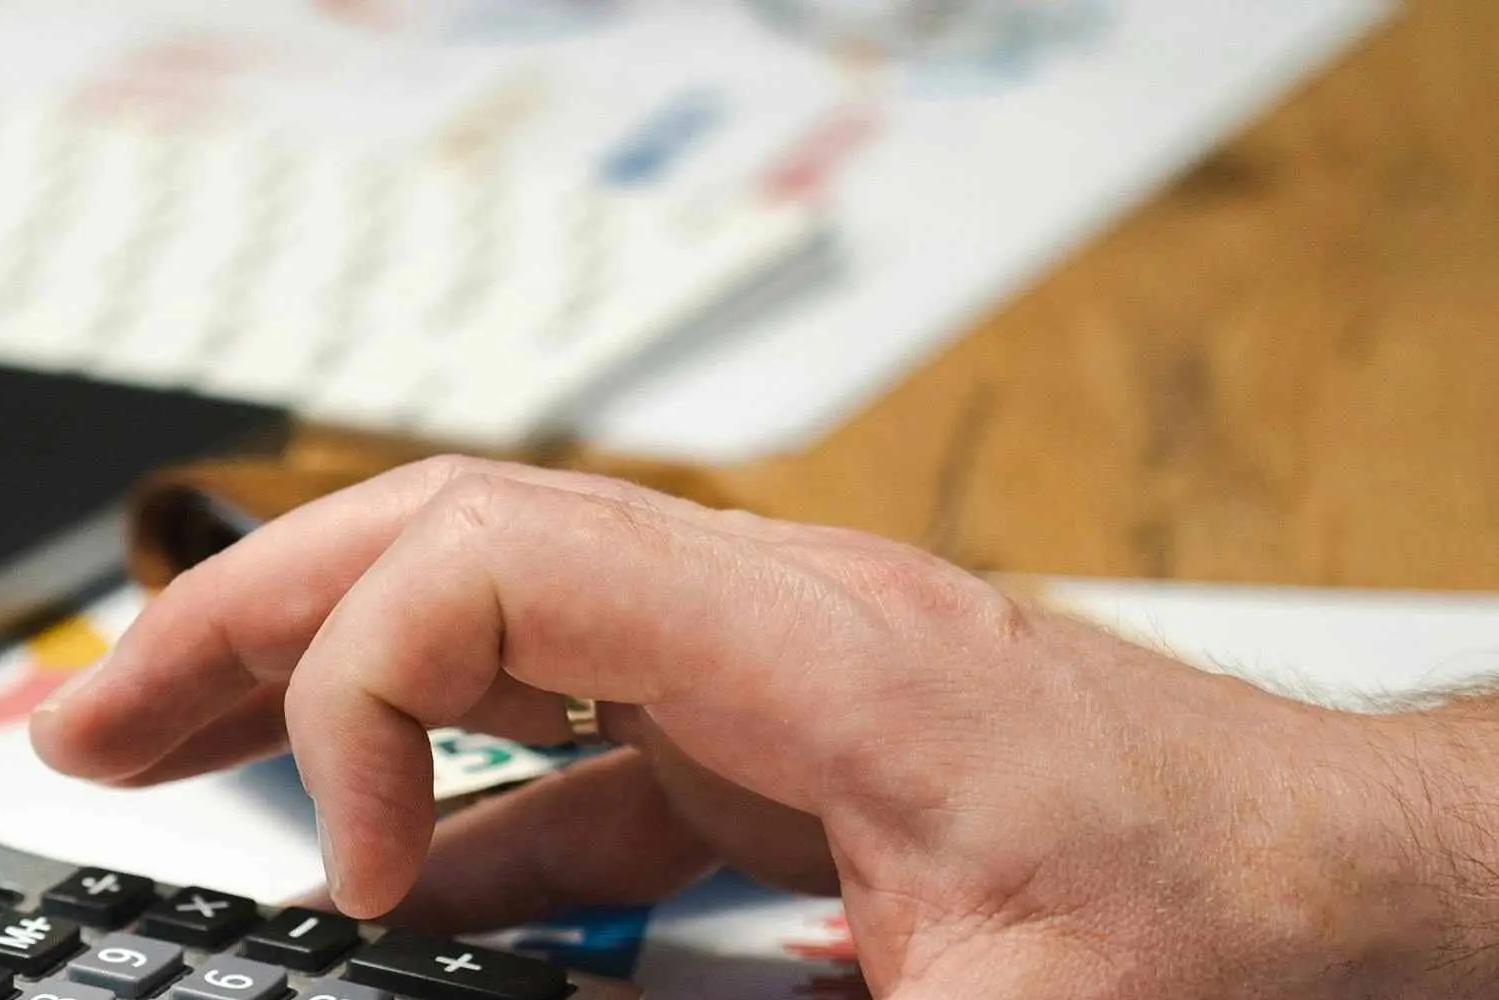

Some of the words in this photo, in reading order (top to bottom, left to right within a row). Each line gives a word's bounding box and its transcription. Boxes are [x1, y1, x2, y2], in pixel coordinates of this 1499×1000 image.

[96, 947, 148, 969] 9
[434, 952, 483, 974] +
[203, 968, 255, 990] 6
